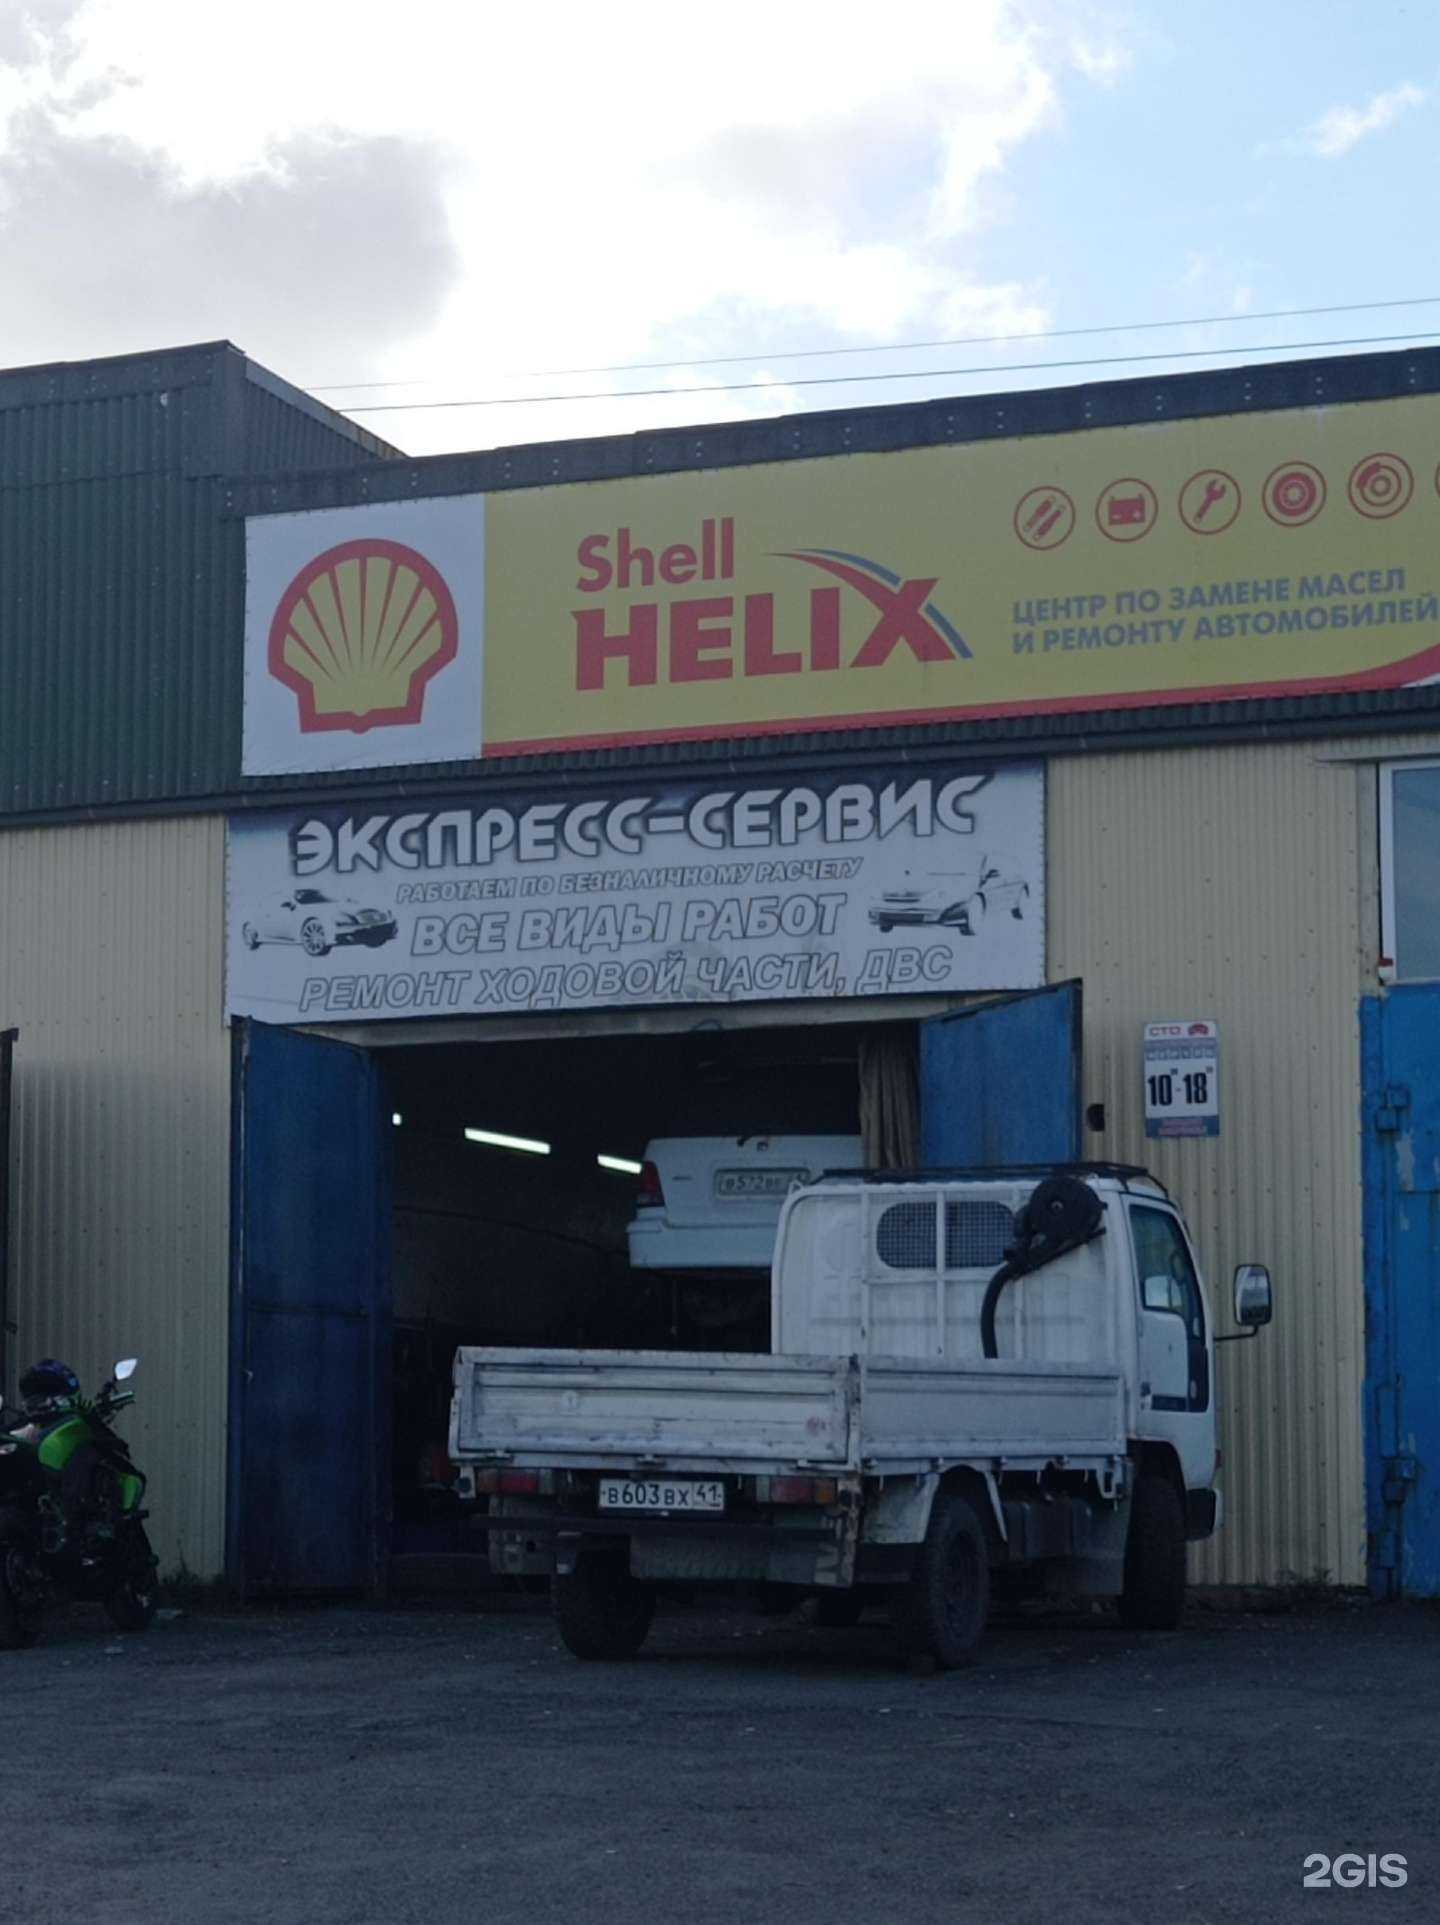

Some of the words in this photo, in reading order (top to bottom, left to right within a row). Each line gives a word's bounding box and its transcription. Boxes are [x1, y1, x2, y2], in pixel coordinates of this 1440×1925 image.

[576, 517, 734, 593] Shell
[571, 550, 972, 690] HELIX
[1011, 632, 1034, 654] И
[1041, 618, 1187, 653] РЕМОНТУ
[1193, 592, 1439, 641] АВТОМОБИЛЕЙ
[1012, 595, 1106, 626] ЦЕНТР
[1115, 588, 1161, 615] ПО
[1169, 577, 1290, 610] ЗАМЕНЕ
[1297, 567, 1407, 599] МАСЕЛ
[294, 774, 990, 877] ЭКСПРЕСС-СЕРВИС
[396, 876, 516, 904] РАБОТАЕМ
[519, 875, 554, 898] ПО
[557, 863, 755, 894] БЕЗНАЛИЧНОМУ
[754, 856, 864, 884] РАСЧЕТУ
[410, 911, 510, 956] ВСЕ
[517, 901, 672, 954] ВИДЫ
[681, 892, 848, 943] РАБОТ
[299, 970, 474, 1013] РЕМОНТ
[474, 950, 686, 1009] ХОДОВОЙ
[855, 944, 954, 994] ДВС
